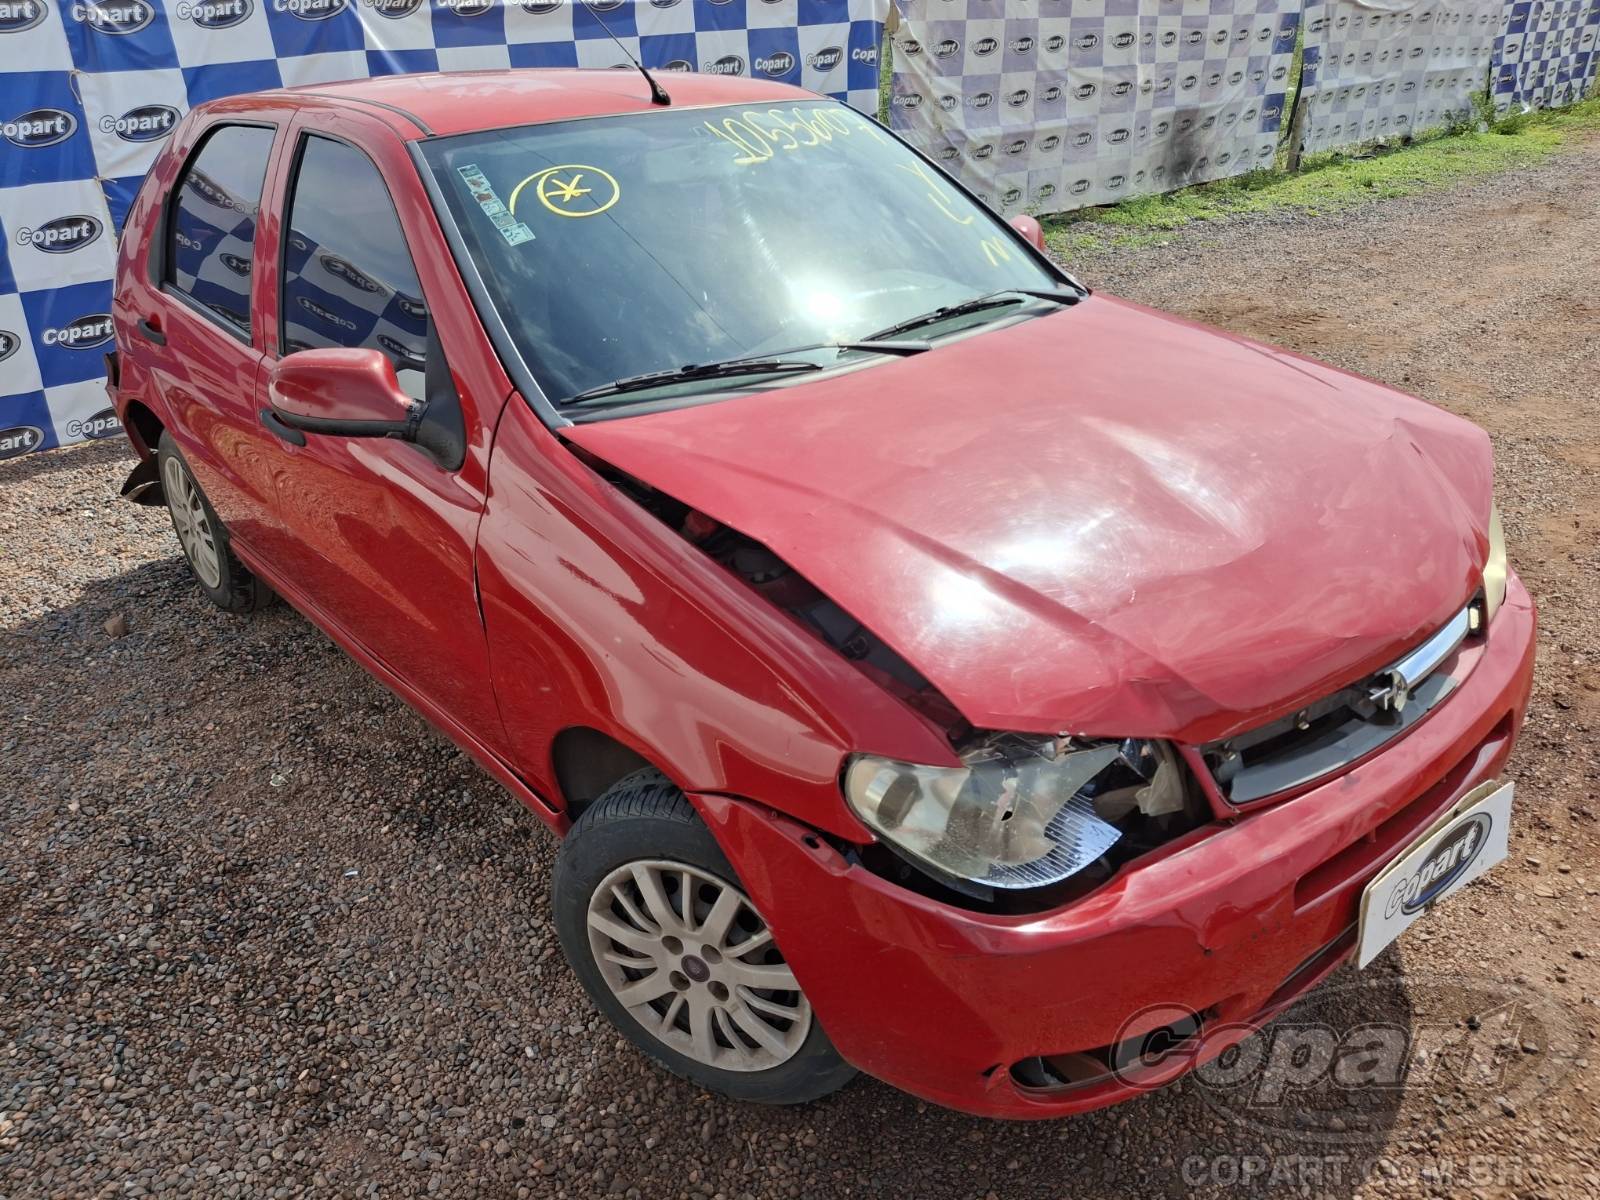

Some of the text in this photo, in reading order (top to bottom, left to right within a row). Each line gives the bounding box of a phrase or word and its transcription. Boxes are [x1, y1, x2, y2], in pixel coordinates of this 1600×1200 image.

[0, 2, 34, 19] art
[72, 3, 142, 25] Copart
[176, 1, 243, 22] Copart
[273, 0, 341, 14] Copart
[754, 56, 790, 72] Copart
[805, 52, 840, 68] Copart
[852, 48, 876, 64] Cop
[703, 60, 739, 74] Copart
[0, 115, 64, 140] opart
[99, 111, 171, 135] Copart
[16, 222, 91, 246] Copart
[42, 318, 114, 345] Copart
[66, 416, 123, 438] Copa
[0, 431, 32, 451] art
[1384, 819, 1480, 919] Copart
